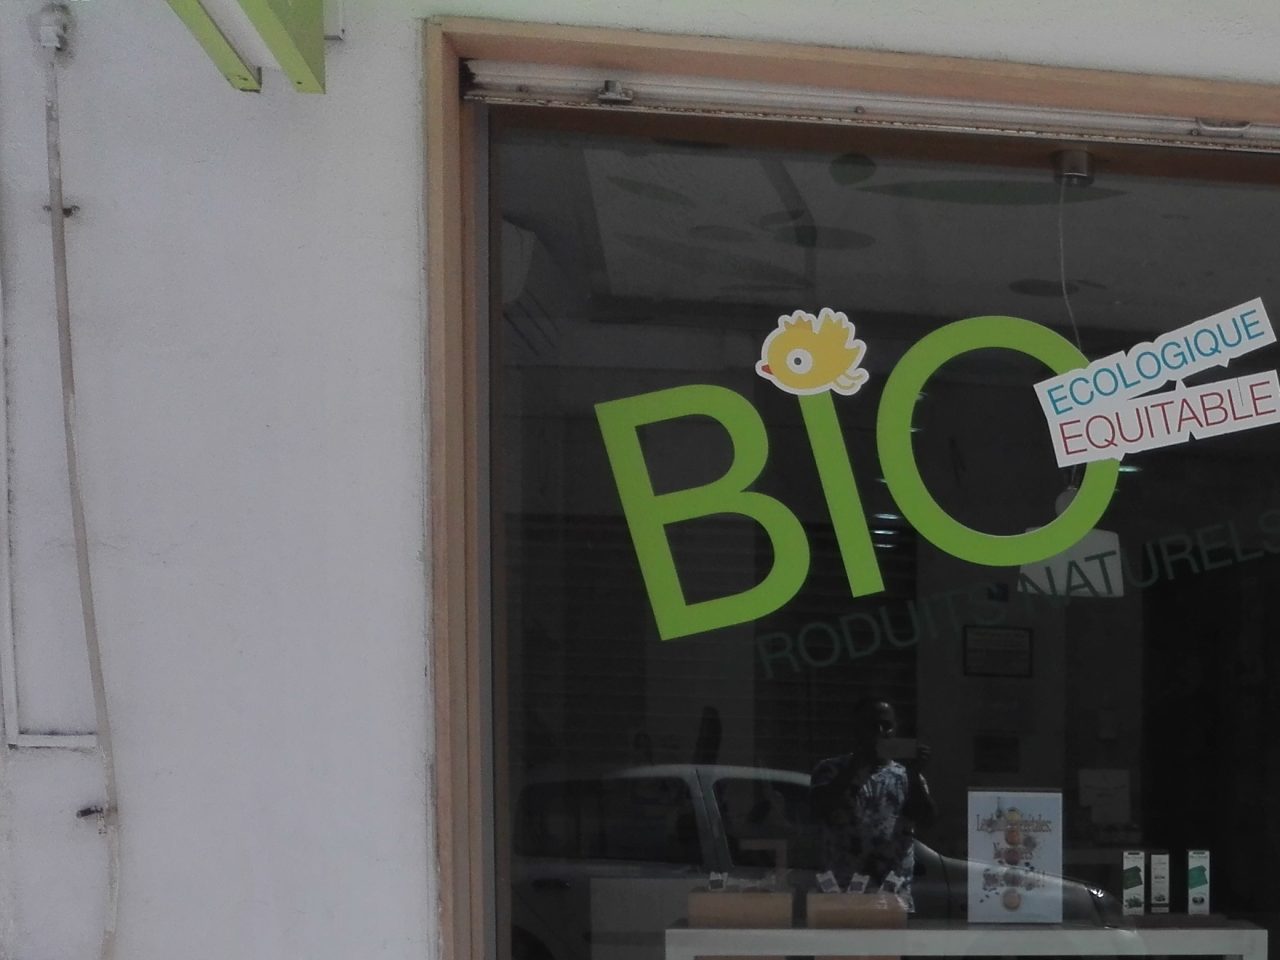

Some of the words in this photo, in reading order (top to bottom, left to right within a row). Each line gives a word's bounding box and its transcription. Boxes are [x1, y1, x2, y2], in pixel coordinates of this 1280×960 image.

[1047, 309, 1265, 415] ECOLOGIQUE
[1059, 381, 1277, 455] EQUITABLE
[757, 580, 1010, 678] RODUITS
